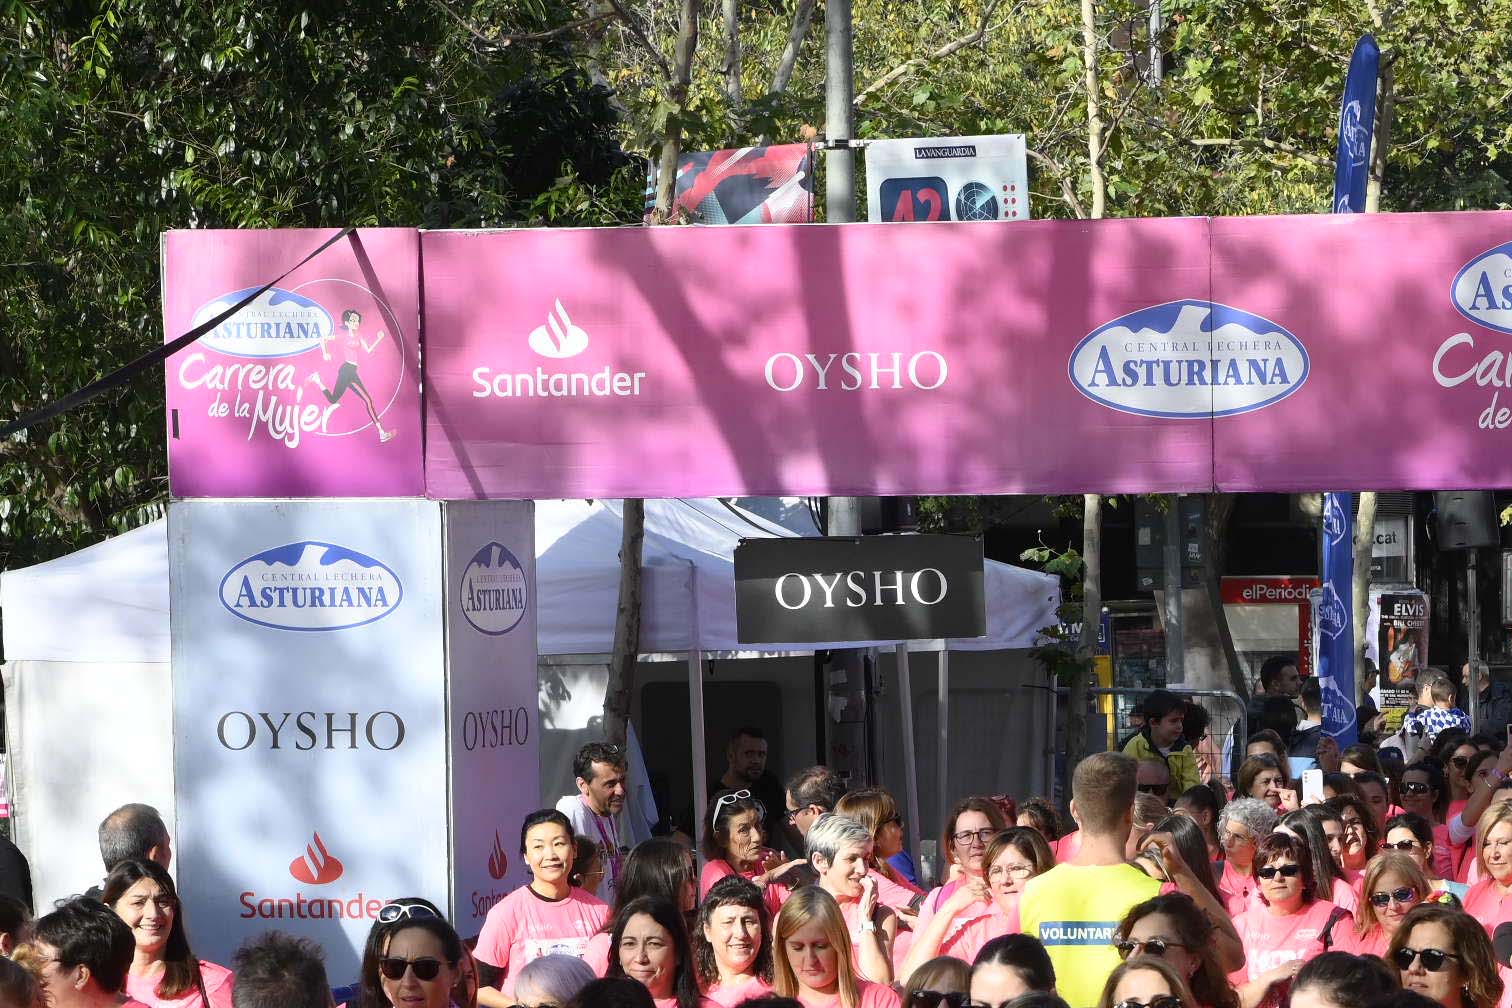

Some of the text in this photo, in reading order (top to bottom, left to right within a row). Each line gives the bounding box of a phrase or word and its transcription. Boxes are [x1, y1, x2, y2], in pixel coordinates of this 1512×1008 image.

[1123, 341, 1284, 352] CENTRAL LECHERA
[178, 352, 296, 390] Carrera
[472, 367, 645, 397] Santander
[764, 350, 949, 392] OYSHO
[1087, 344, 1291, 389] ASTURIANA
[208, 386, 341, 449] de la Mujer
[1478, 389, 1512, 430] de
[234, 574, 389, 609] ASTURIANA
[260, 571, 383, 583] CENTRAL LECHERA
[466, 577, 524, 613] ASTURIANA
[774, 567, 949, 611] OYSHO
[1243, 583, 1311, 601] elPeriódi
[1393, 603, 1425, 616] ELVIS
[217, 710, 406, 751] OYSHO
[463, 706, 529, 751] OYSHO
